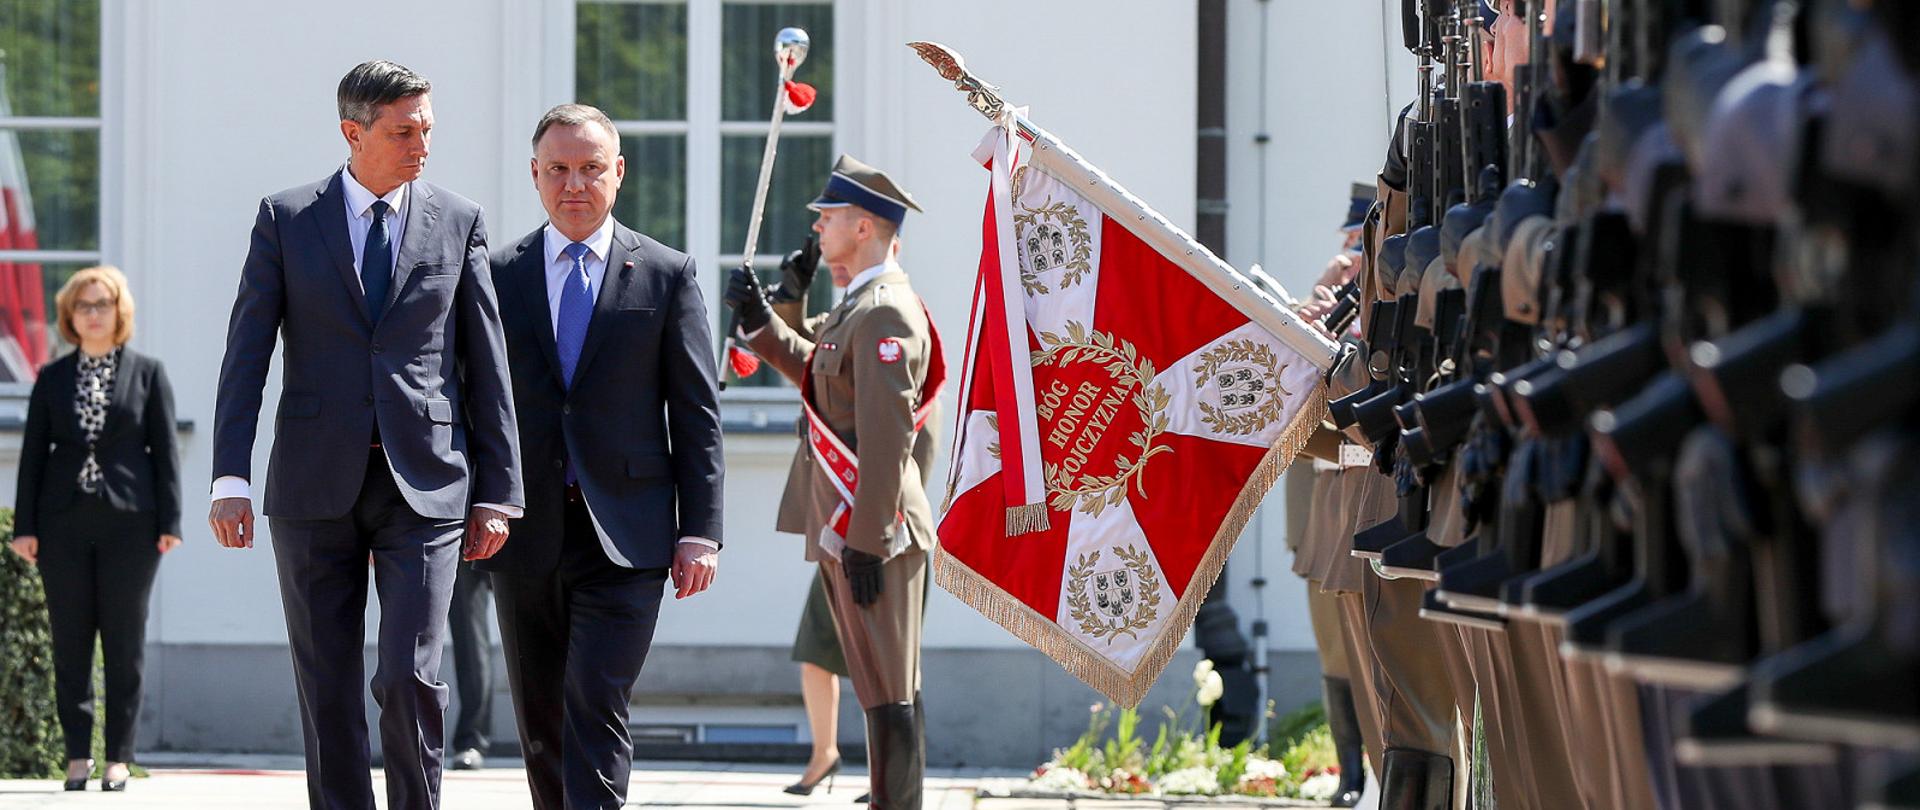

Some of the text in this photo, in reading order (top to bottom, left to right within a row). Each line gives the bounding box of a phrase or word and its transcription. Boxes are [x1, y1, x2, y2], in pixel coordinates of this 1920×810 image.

[1038, 379, 1070, 422] BÓG
[1048, 381, 1102, 450] HONOR
[1063, 385, 1130, 473] OJCZYZNA
